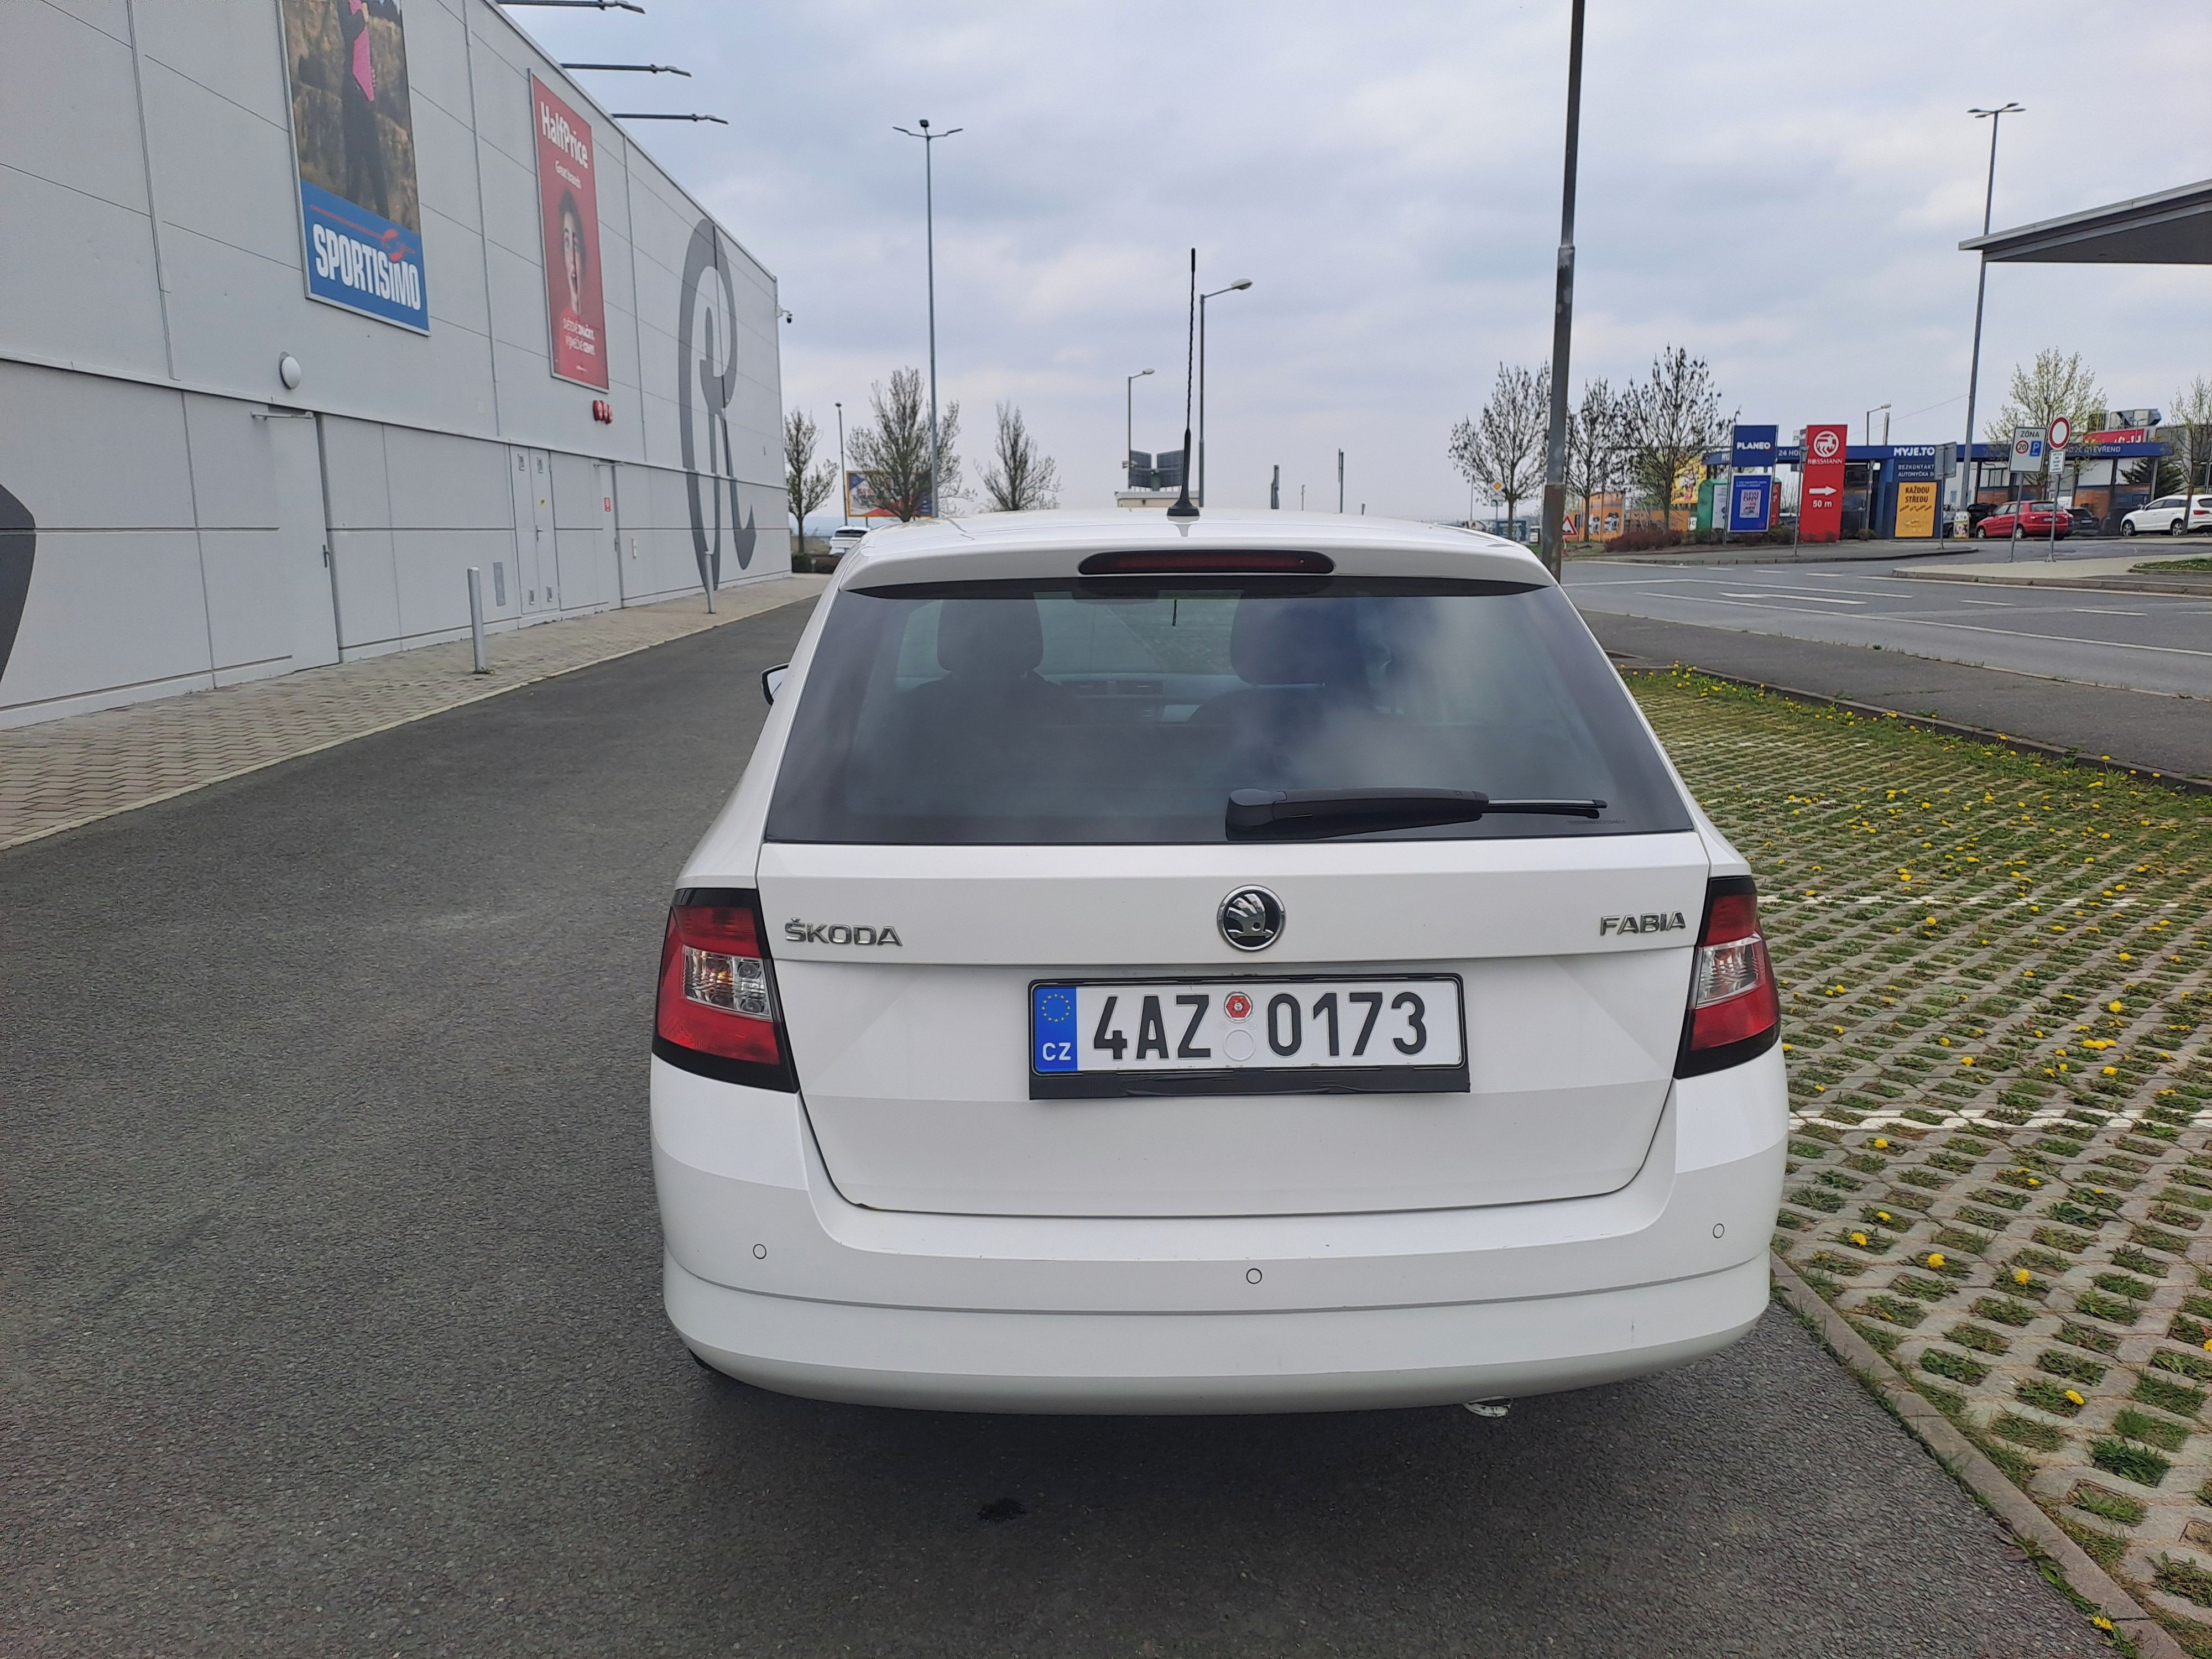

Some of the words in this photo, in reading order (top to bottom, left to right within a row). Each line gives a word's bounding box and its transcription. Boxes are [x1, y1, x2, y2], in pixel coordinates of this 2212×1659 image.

[540, 101, 588, 169] HalfPrice
[312, 223, 421, 311] SPORTISIMO
[1736, 442, 1772, 450] PLANEO
[1893, 447, 1935, 456] MYJE.TO
[1905, 485, 1930, 494] KAŽDOU
[1905, 495, 1928, 503] STŘEDU
[785, 917, 903, 947] ŠKODA
[1600, 910, 1686, 936] FABIA
[1093, 994, 1211, 1060] 4AZ
[1267, 992, 1427, 1056] 0173
[1042, 1042, 1072, 1061] CZ
